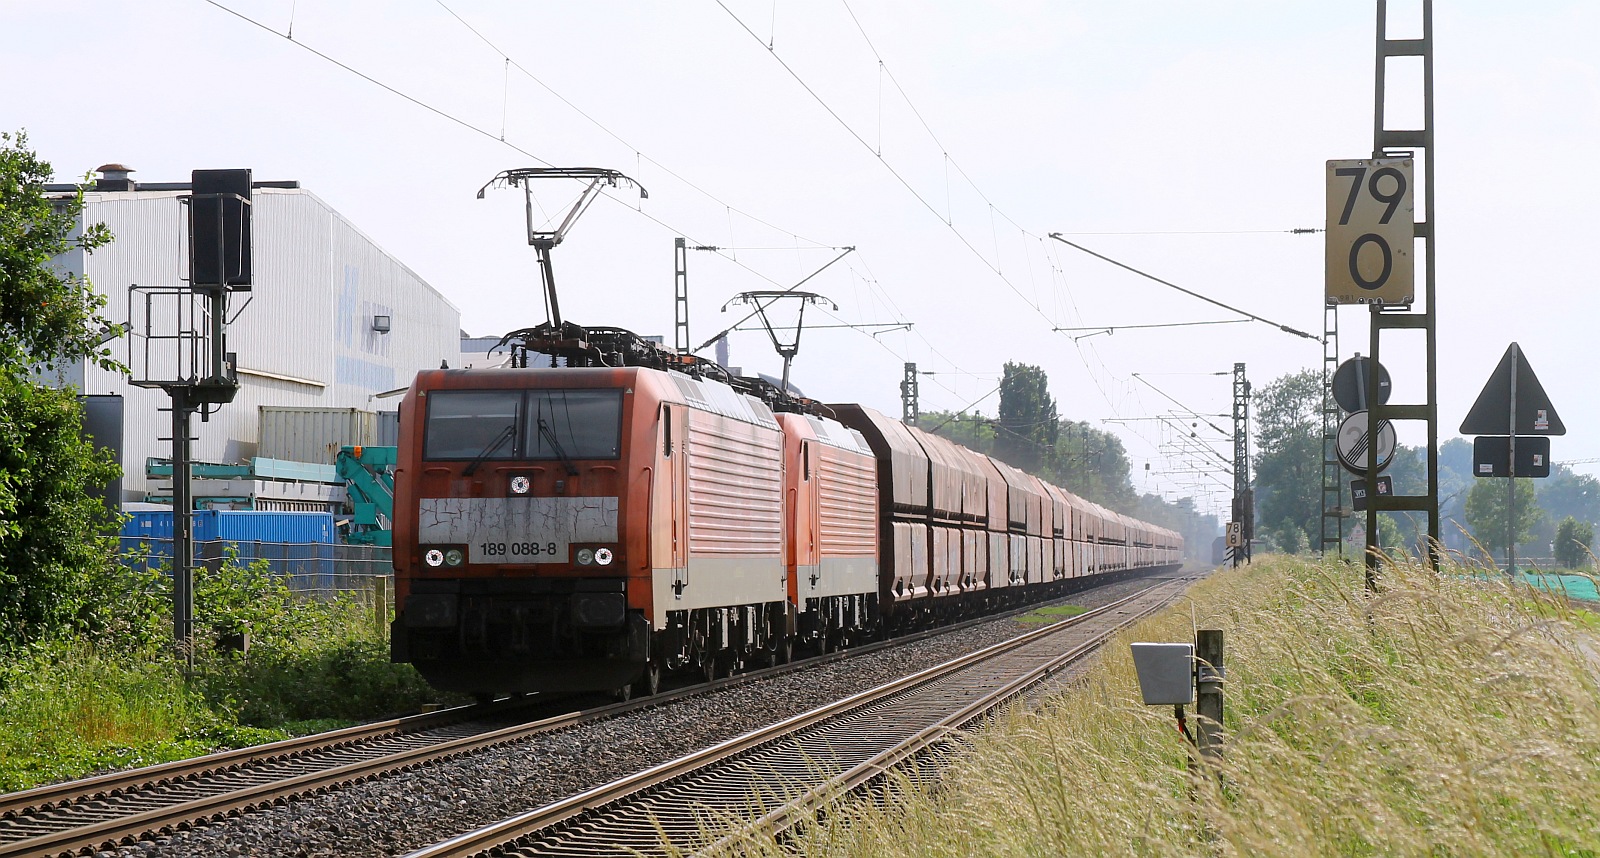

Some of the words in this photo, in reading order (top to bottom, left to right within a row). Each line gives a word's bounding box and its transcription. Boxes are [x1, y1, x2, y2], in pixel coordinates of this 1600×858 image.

[1335, 167, 1407, 226] 79
[1348, 232, 1393, 291] 0
[1227, 523, 1240, 534] 78
[1230, 534, 1237, 544] 8
[480, 542, 507, 556] 189
[511, 542, 557, 556] 088-8
